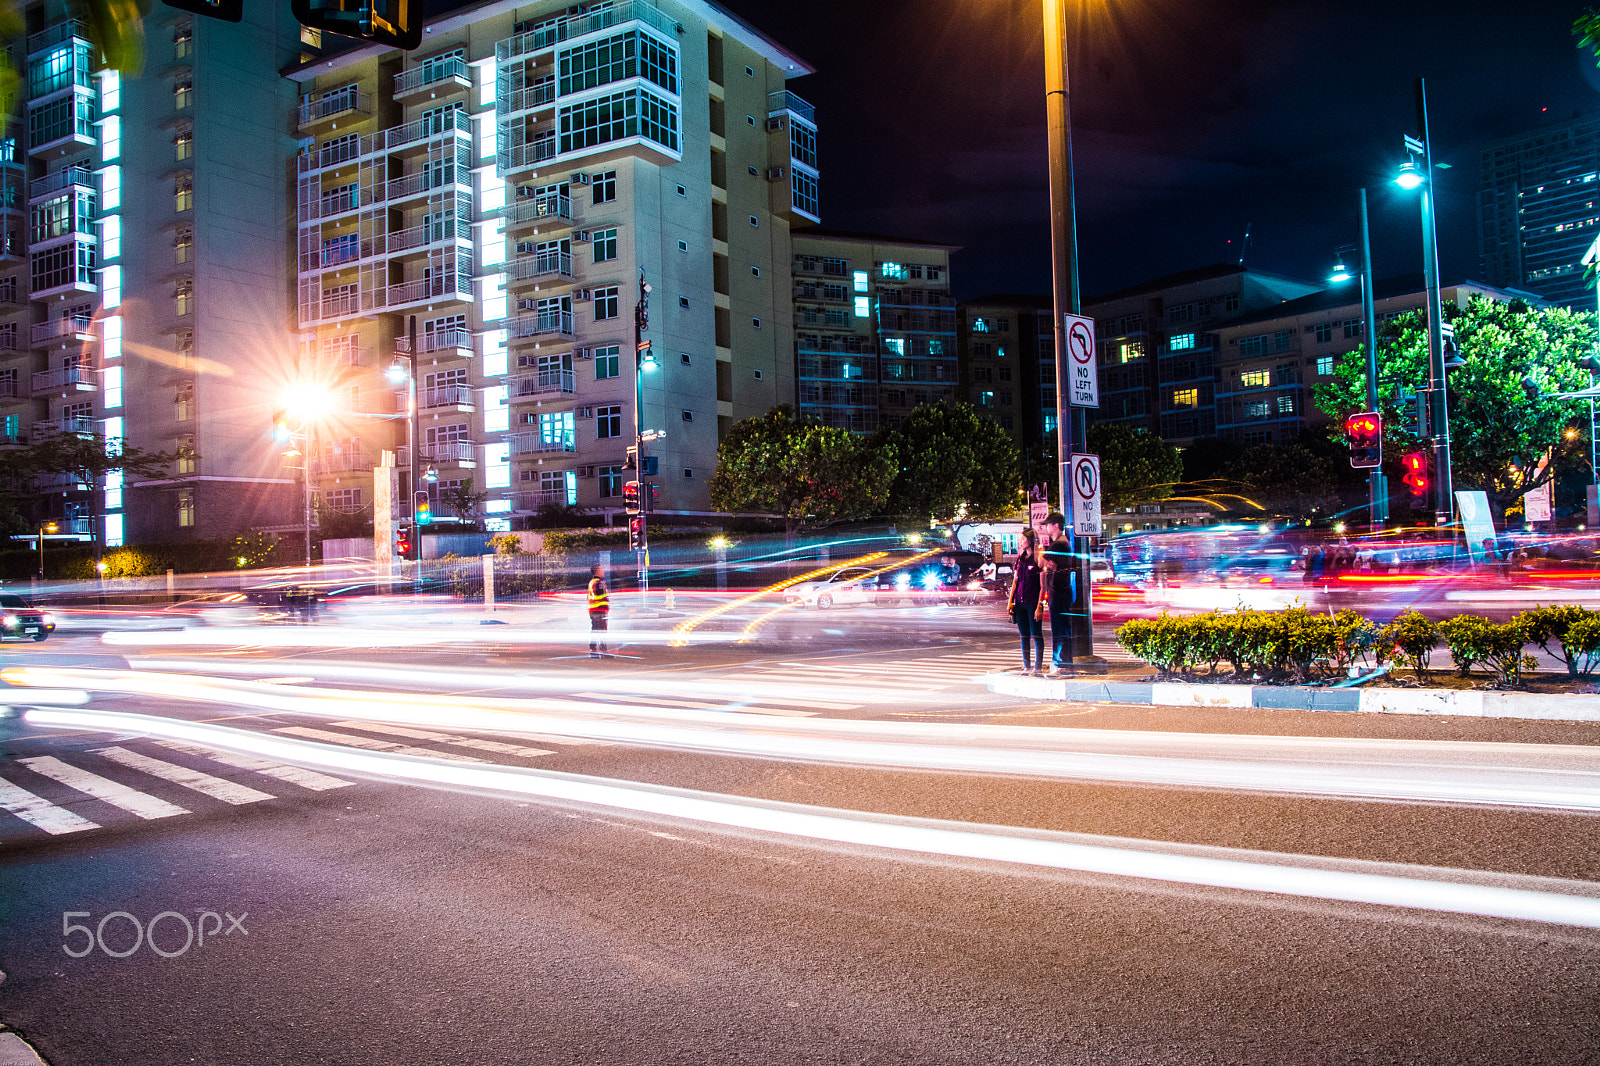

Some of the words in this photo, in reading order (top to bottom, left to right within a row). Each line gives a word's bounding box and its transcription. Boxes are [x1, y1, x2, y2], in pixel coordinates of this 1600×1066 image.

[1077, 366, 1089, 378] NO
[1075, 379, 1092, 390] LEFT
[1075, 391, 1094, 402] TURN
[1082, 501, 1094, 511] NO
[1086, 512, 1091, 521] U
[1080, 522, 1097, 532] TURN
